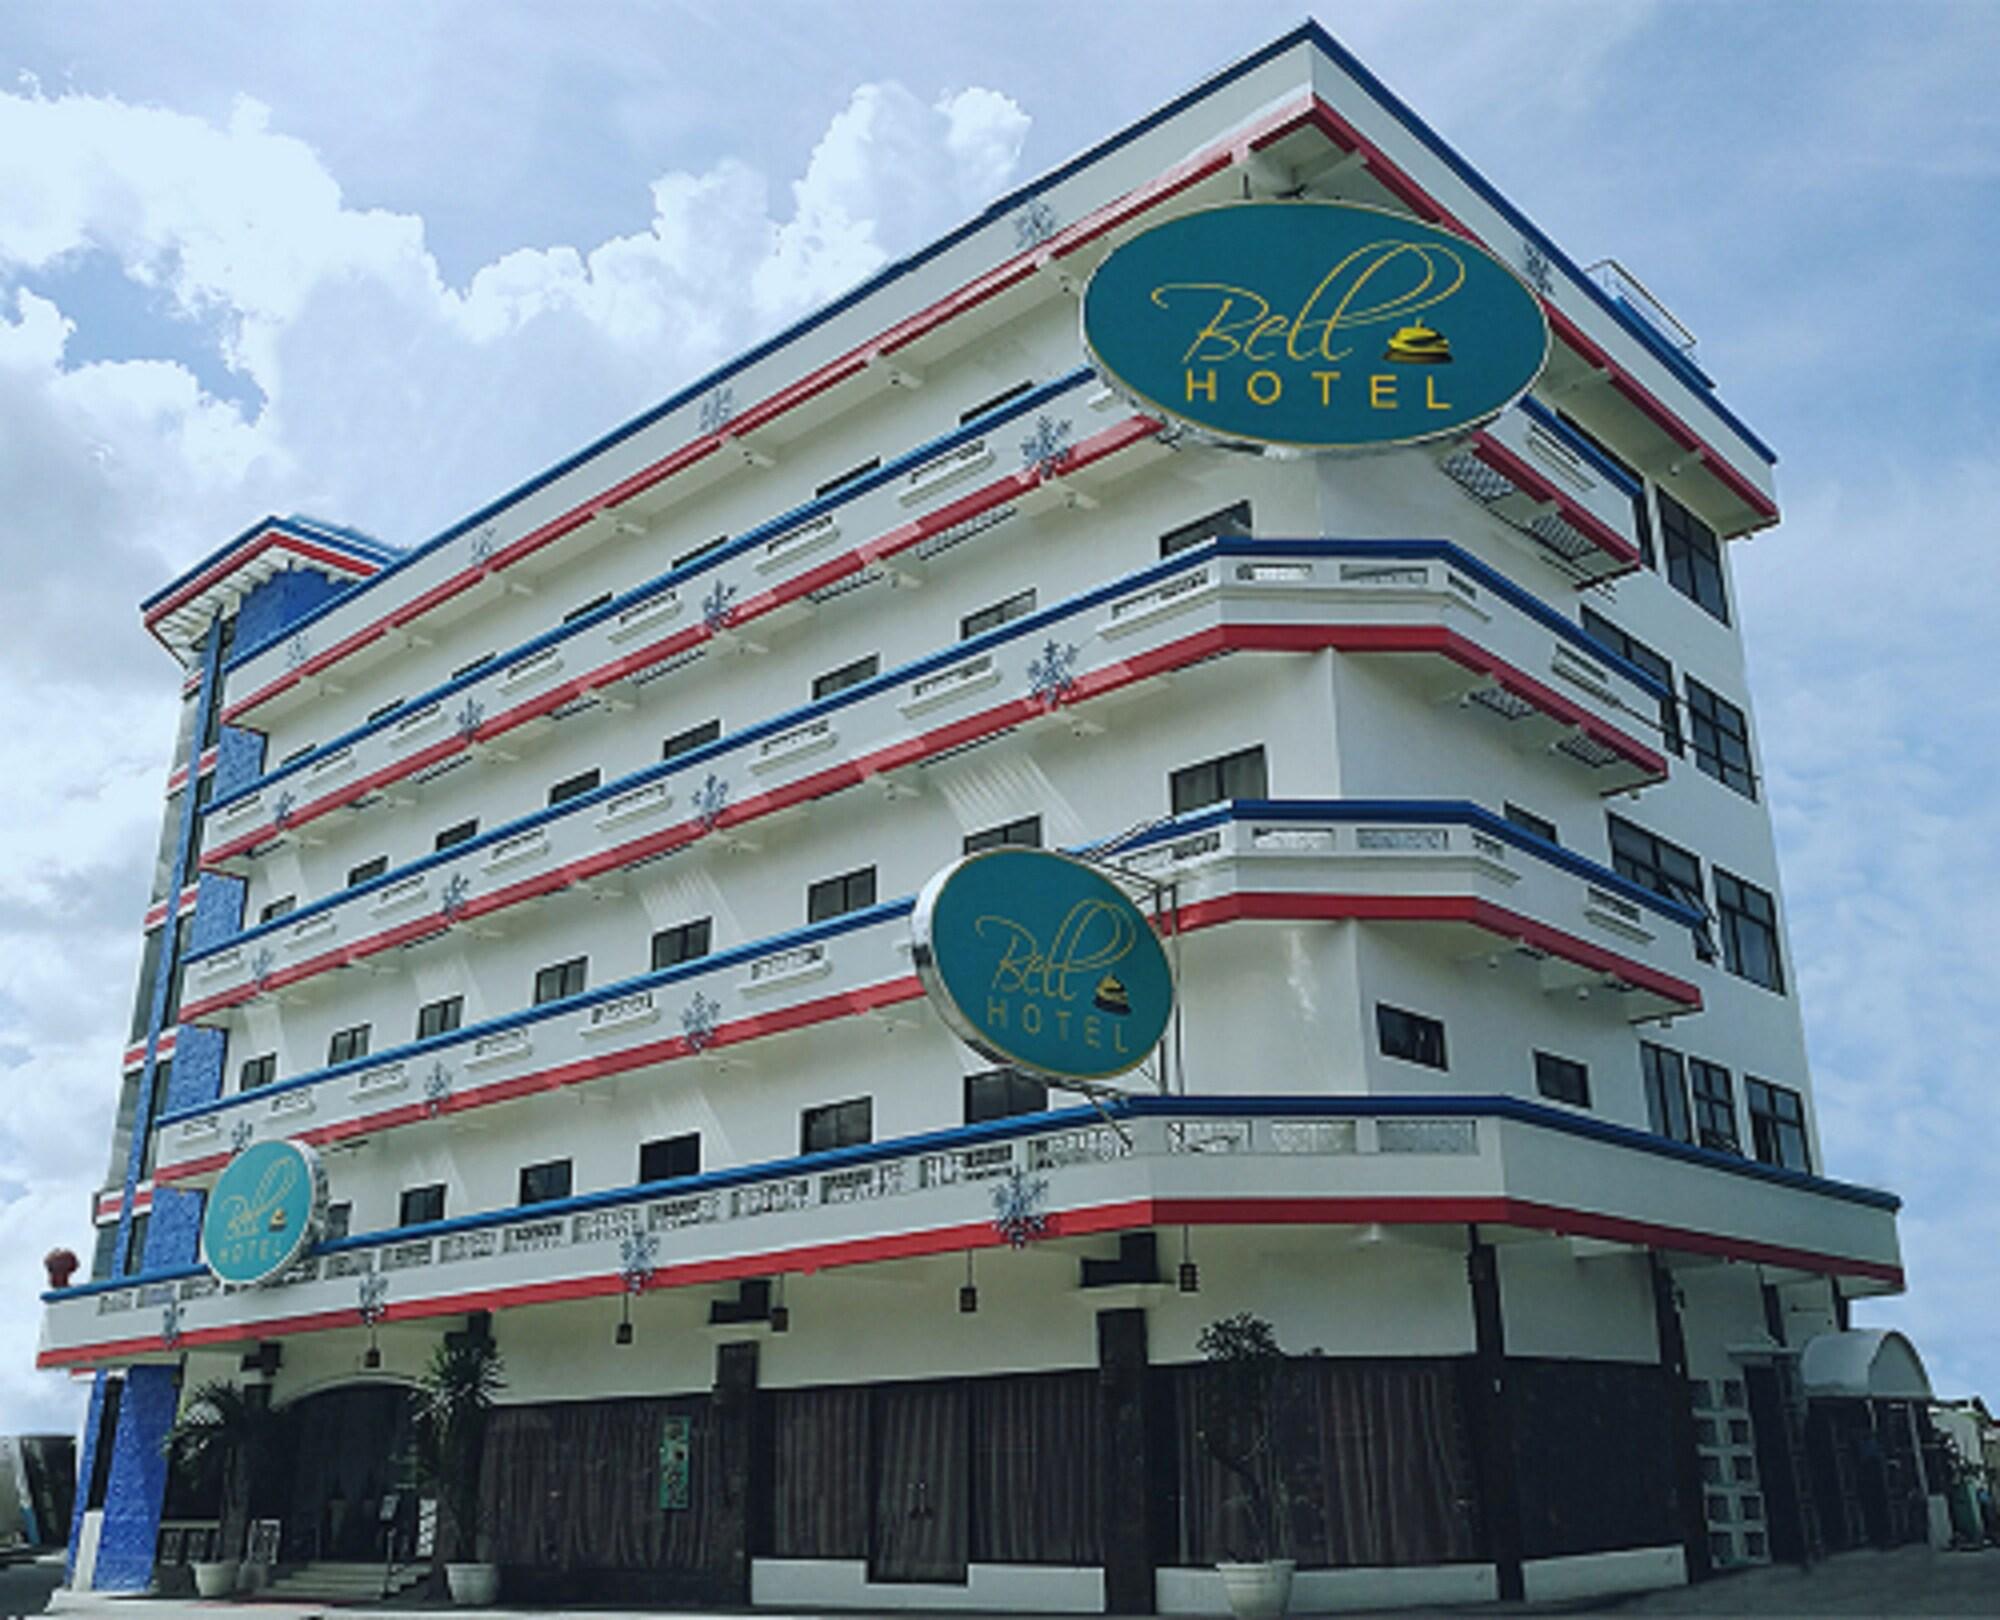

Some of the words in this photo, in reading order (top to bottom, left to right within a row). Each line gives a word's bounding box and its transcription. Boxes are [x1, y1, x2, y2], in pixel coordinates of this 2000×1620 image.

[1150, 239, 1465, 364] Bell
[1184, 368, 1452, 410] HOTEL
[974, 898, 1137, 1001] Bell
[986, 995, 1129, 1053] HOTEL
